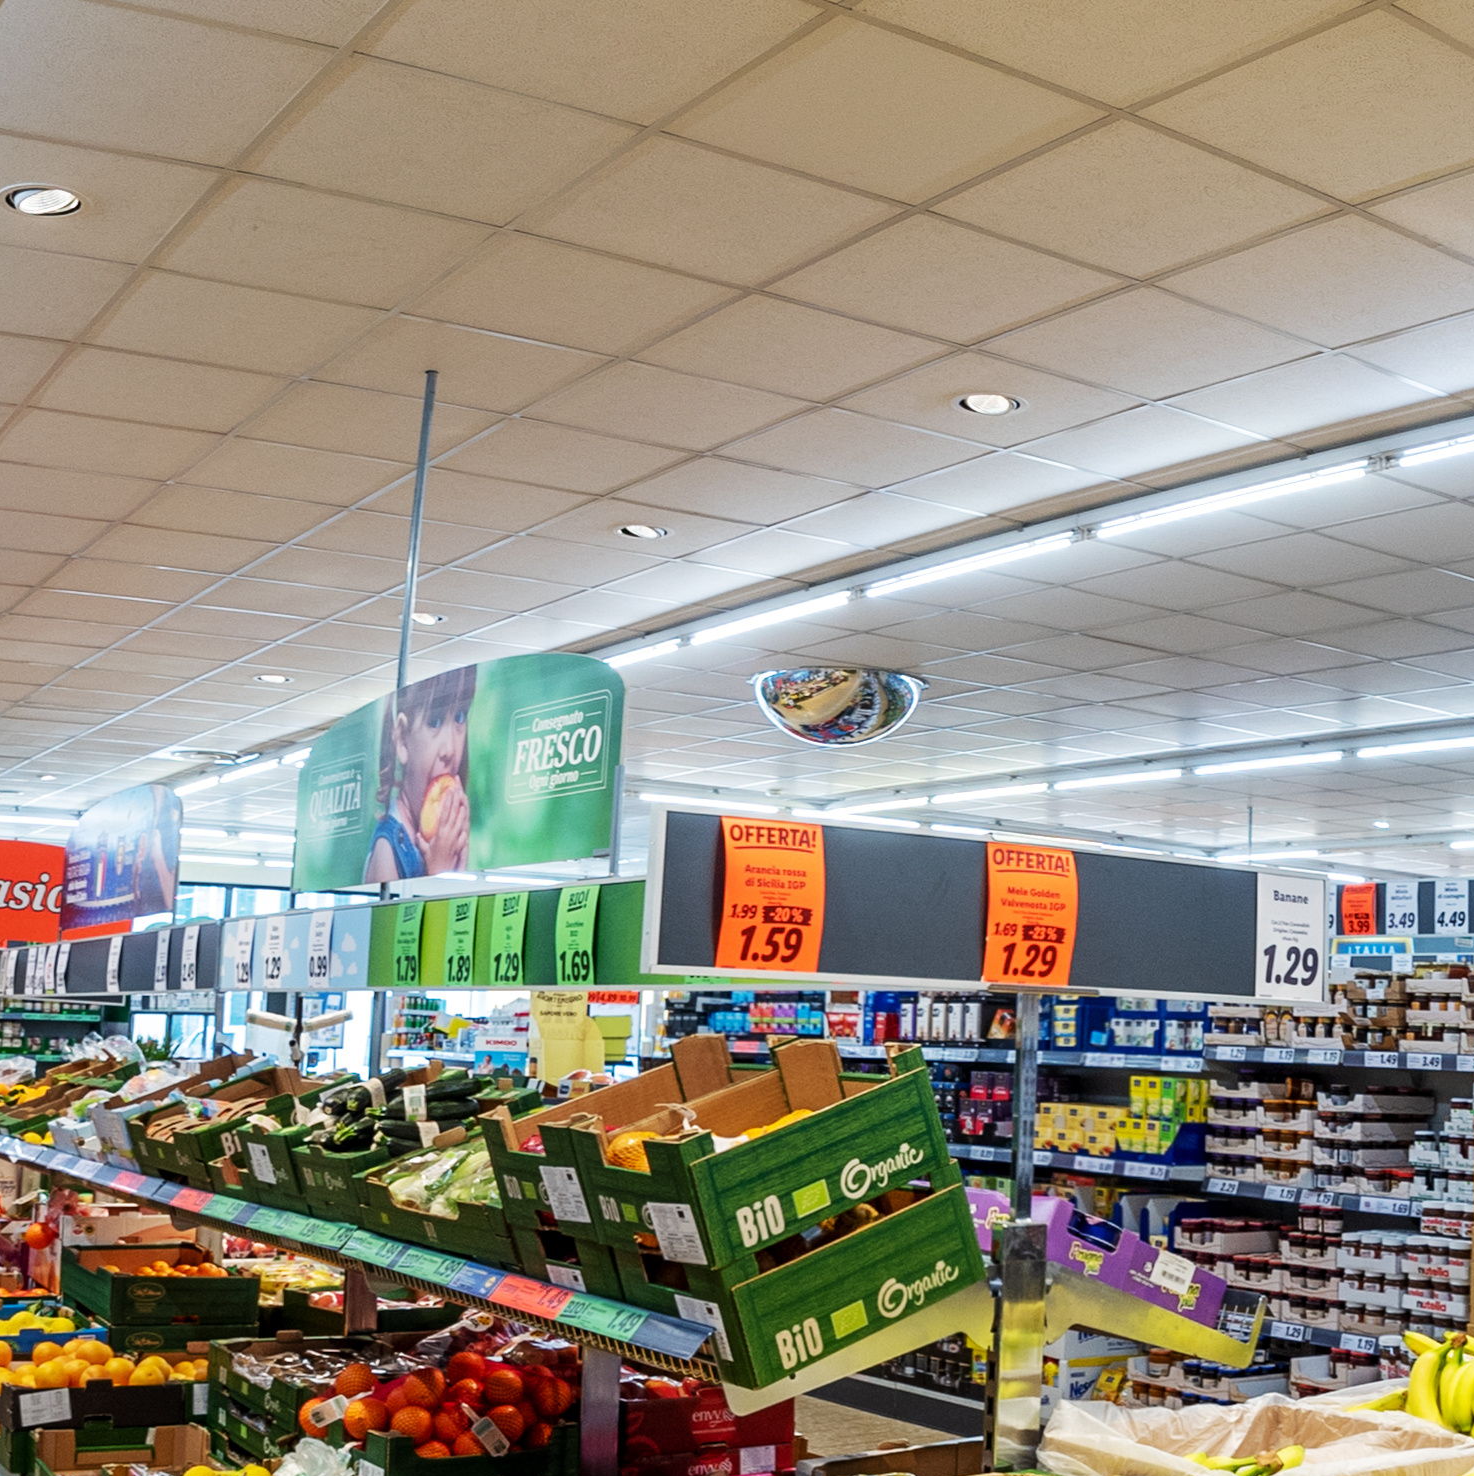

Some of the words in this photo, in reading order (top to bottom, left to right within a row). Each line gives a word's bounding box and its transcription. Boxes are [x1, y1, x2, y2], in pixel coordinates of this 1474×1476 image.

[532, 710, 584, 732] Consegnato
[512, 725, 602, 776] FRESCO
[528, 774, 549, 790] Ogni
[550, 770, 579, 789] giorno
[310, 773, 362, 822] QUALITÀ
[730, 824, 817, 849] OFFERTA!
[993, 848, 1069, 873] OFFERTA!
[745, 864, 781, 876] Arancia
[783, 868, 807, 878] rossa
[745, 877, 755, 887] di
[757, 878, 785, 889] Sicilia
[787, 879, 806, 890] IGP
[1029, 889, 1060, 899] Golden
[1273, 890, 1309, 905] Banane
[729, 904, 757, 919] 1.99
[768, 908, 803, 923] -20%
[1049, 901, 1066, 911] IGP
[1348, 920, 1369, 934] 3.99
[1388, 912, 1415, 929] 3.49
[1437, 911, 1465, 927] 4.49
[994, 922, 1017, 937] 1.69
[1028, 927, 1058, 941] -23%
[739, 926, 802, 963] 1.59
[265, 955, 281, 979] 1.29
[309, 954, 327, 978] 0.99
[395, 955, 416, 982] 1.79
[447, 955, 471, 982] 1.89
[494, 951, 519, 981] 1.29
[559, 950, 590, 981] 1.69
[1003, 942, 1057, 978] 1.29
[1263, 944, 1319, 986] 1.29
[1380, 1052, 1397, 1065] 1.49
[1422, 1055, 1441, 1067] 3.49
[736, 1194, 785, 1248] BiO
[840, 1142, 924, 1200] Organic
[1220, 1181, 1236, 1192] 2.29
[1279, 1188, 1296, 1200] 1.19
[599, 1194, 621, 1223] BiO
[1392, 1201, 1408, 1214] 1.69
[1418, 1266, 1449, 1278] nutella
[775, 1317, 824, 1370] BiO
[877, 1259, 960, 1319] Organic
[1416, 1301, 1447, 1312] nutella
[604, 1308, 642, 1334] 1.49
[1285, 1325, 1301, 1337] 1.29
[1356, 1338, 1373, 1351] 1.19
[692, 1409, 722, 1428] envy
